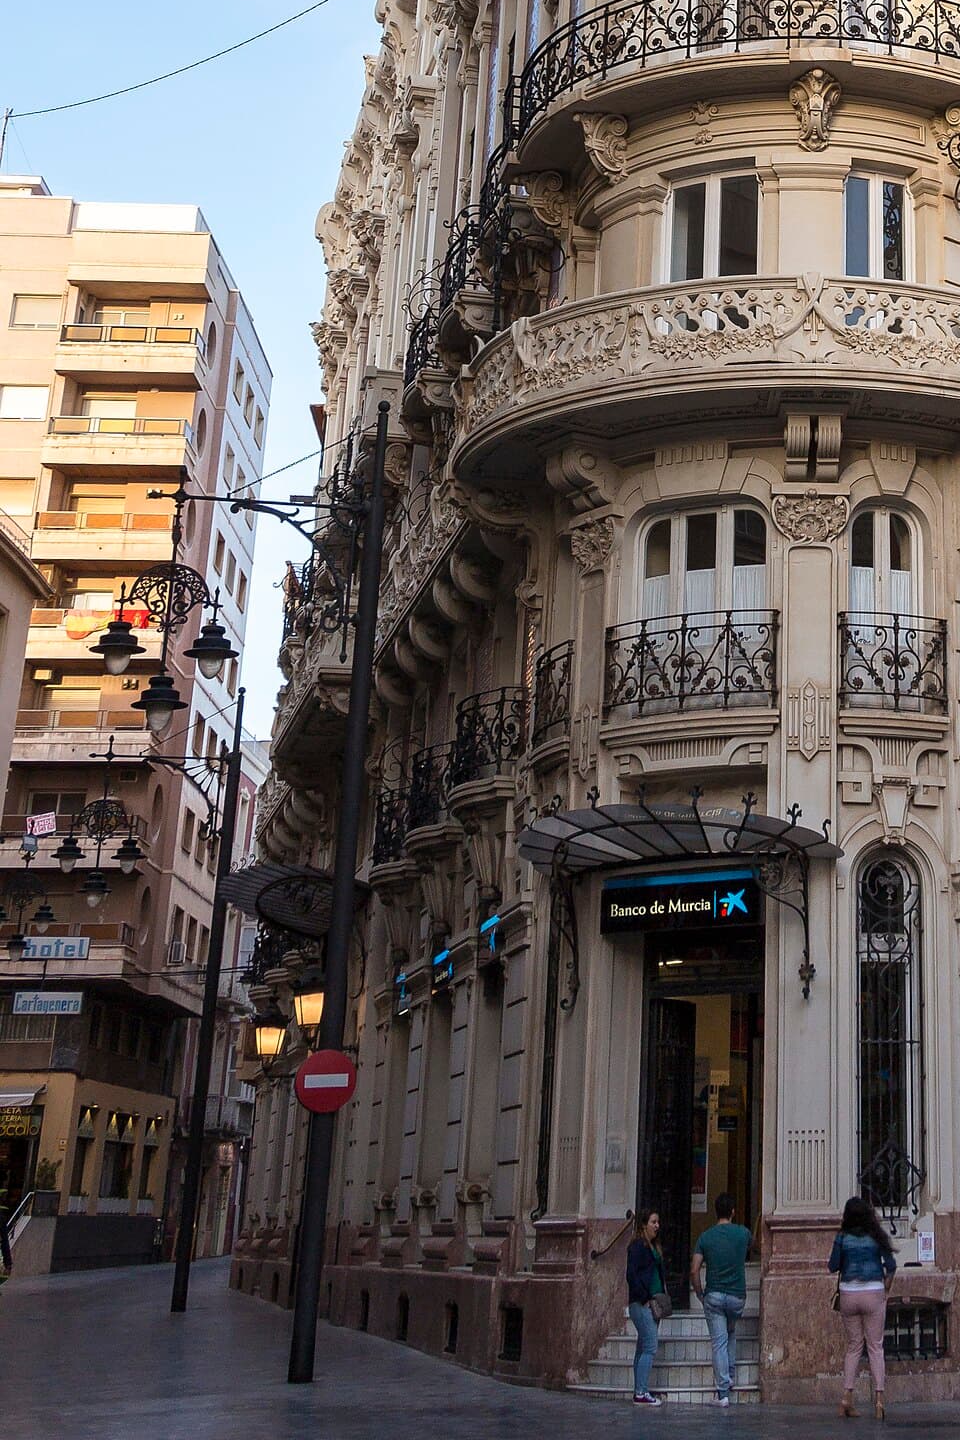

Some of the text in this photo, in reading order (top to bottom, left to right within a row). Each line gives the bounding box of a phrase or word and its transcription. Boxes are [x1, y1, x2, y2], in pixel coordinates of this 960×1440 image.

[610, 898, 711, 918] Banco de Murcia
[24, 938, 86, 958] hotel
[14, 994, 80, 1015] Cartagenera
